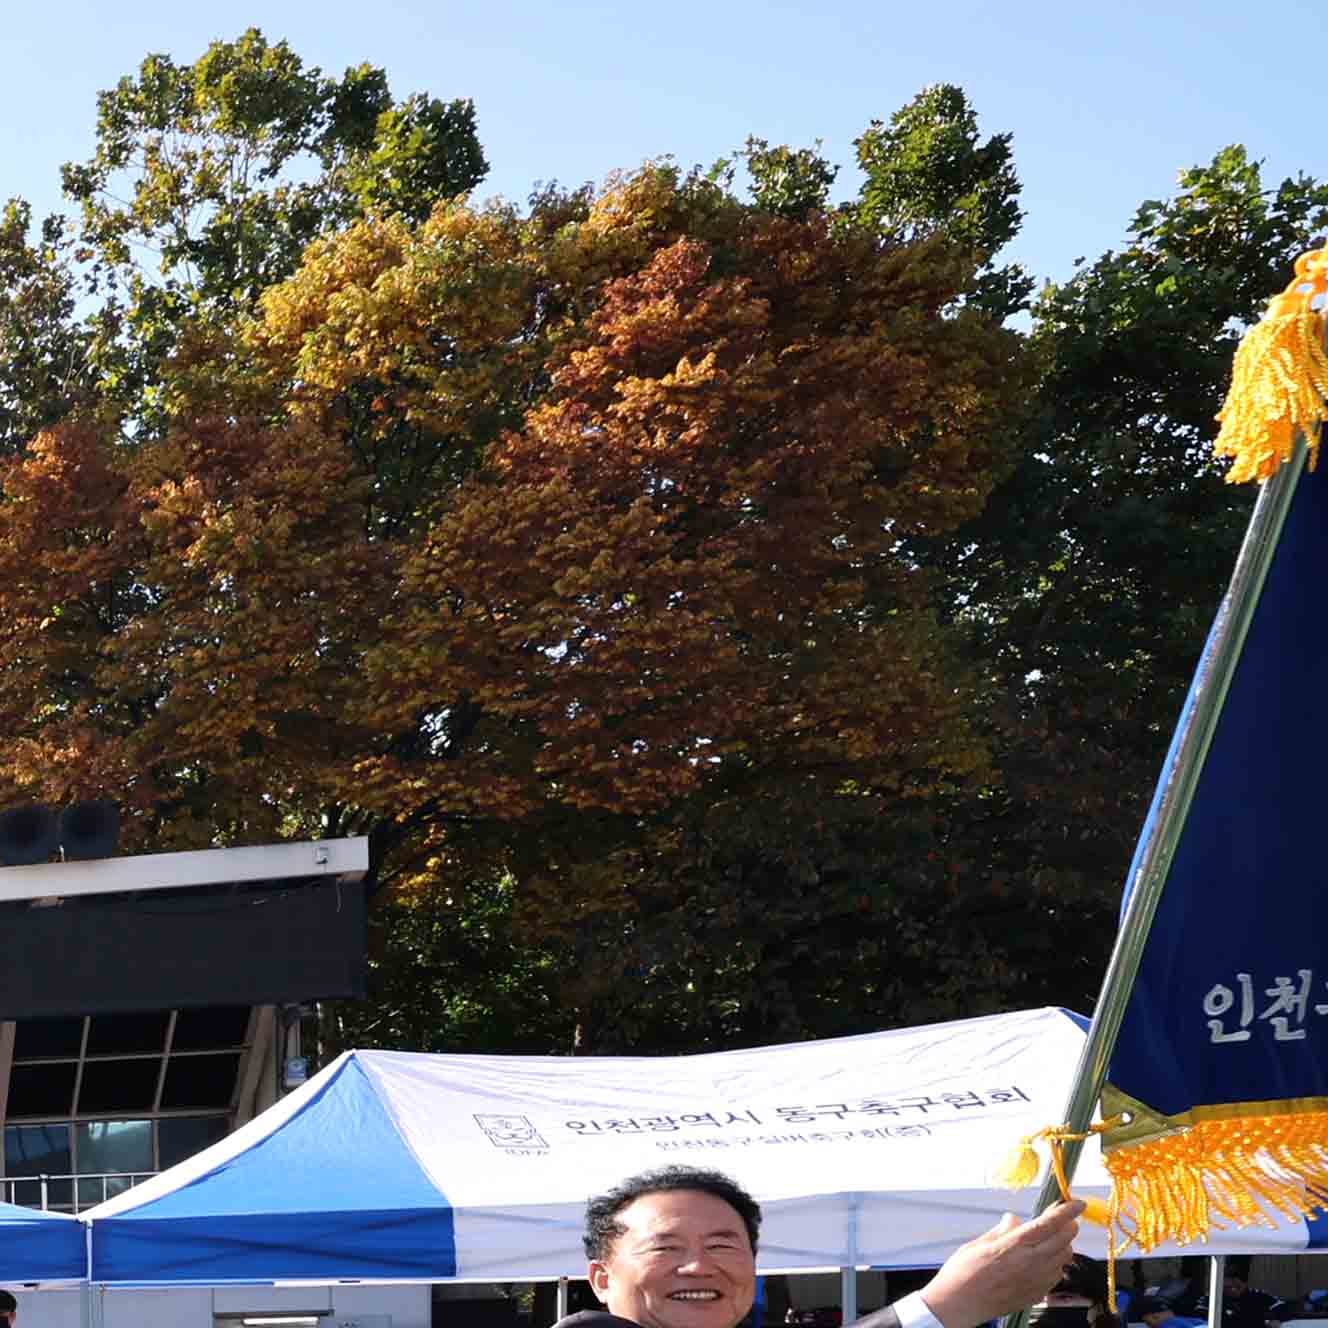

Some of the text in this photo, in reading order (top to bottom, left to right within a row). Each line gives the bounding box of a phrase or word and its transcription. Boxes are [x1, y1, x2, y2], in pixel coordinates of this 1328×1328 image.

[1202, 968, 1328, 1044] 인천
[564, 1085, 1031, 1136] 인천광역시 동구축구협회
